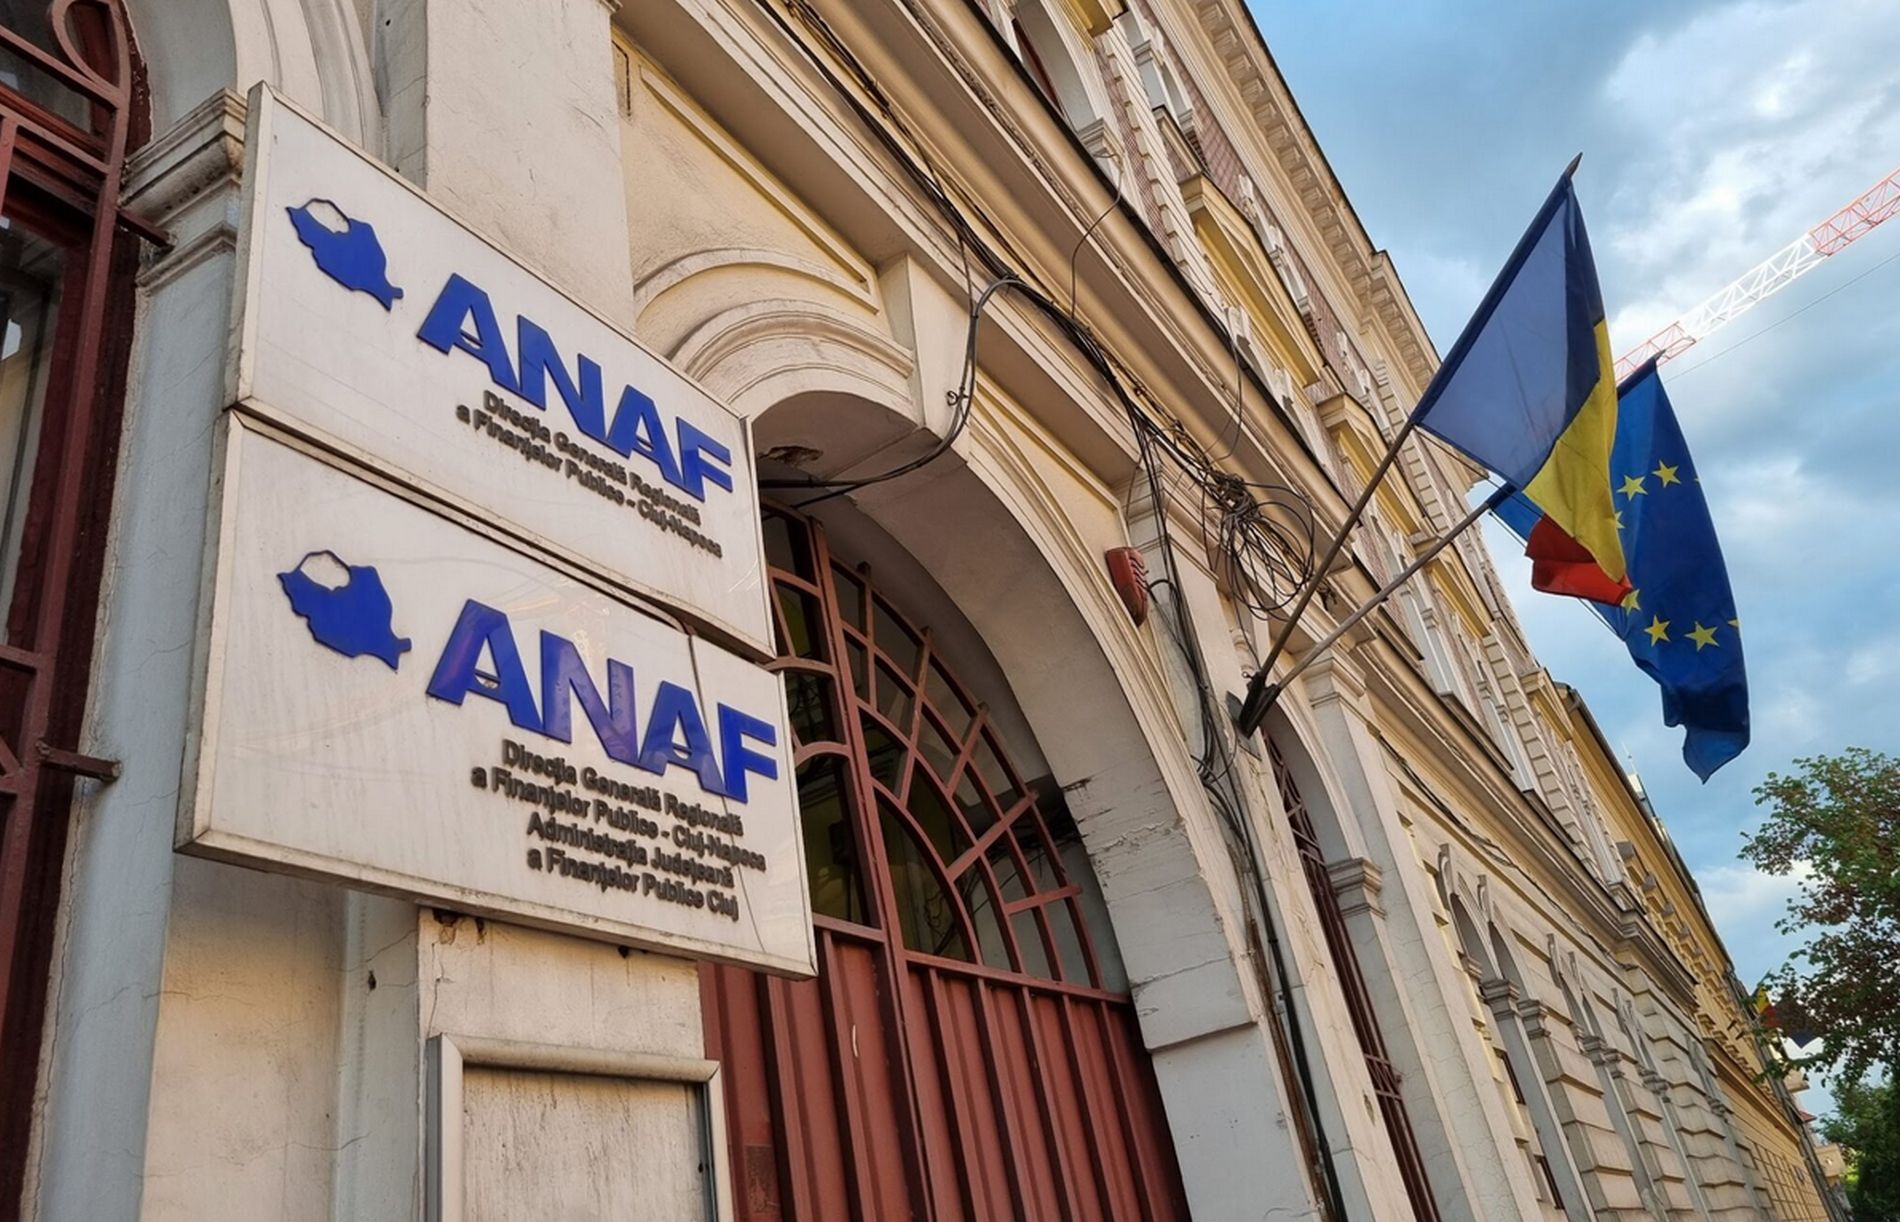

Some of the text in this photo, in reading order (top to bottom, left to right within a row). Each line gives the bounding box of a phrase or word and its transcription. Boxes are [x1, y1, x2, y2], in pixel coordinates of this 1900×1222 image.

[417, 272, 733, 502] ANAF
[455, 404, 471, 424] a
[473, 409, 563, 472] Finanțelor
[565, 460, 624, 506] Publice
[637, 499, 722, 558] Cluj-Napoca
[484, 390, 701, 526] Direcția Generală Regională
[426, 599, 778, 804] ANAF
[471, 766, 487, 788] a
[492, 767, 591, 818] Finanțelor
[594, 799, 658, 839] Publice
[672, 825, 766, 872] Cluj-Napoca
[502, 739, 743, 836] Direcția Generală Regională
[527, 811, 735, 888] Administrația Județeană
[527, 847, 738, 921] a Finanțelor Publice Cluj
